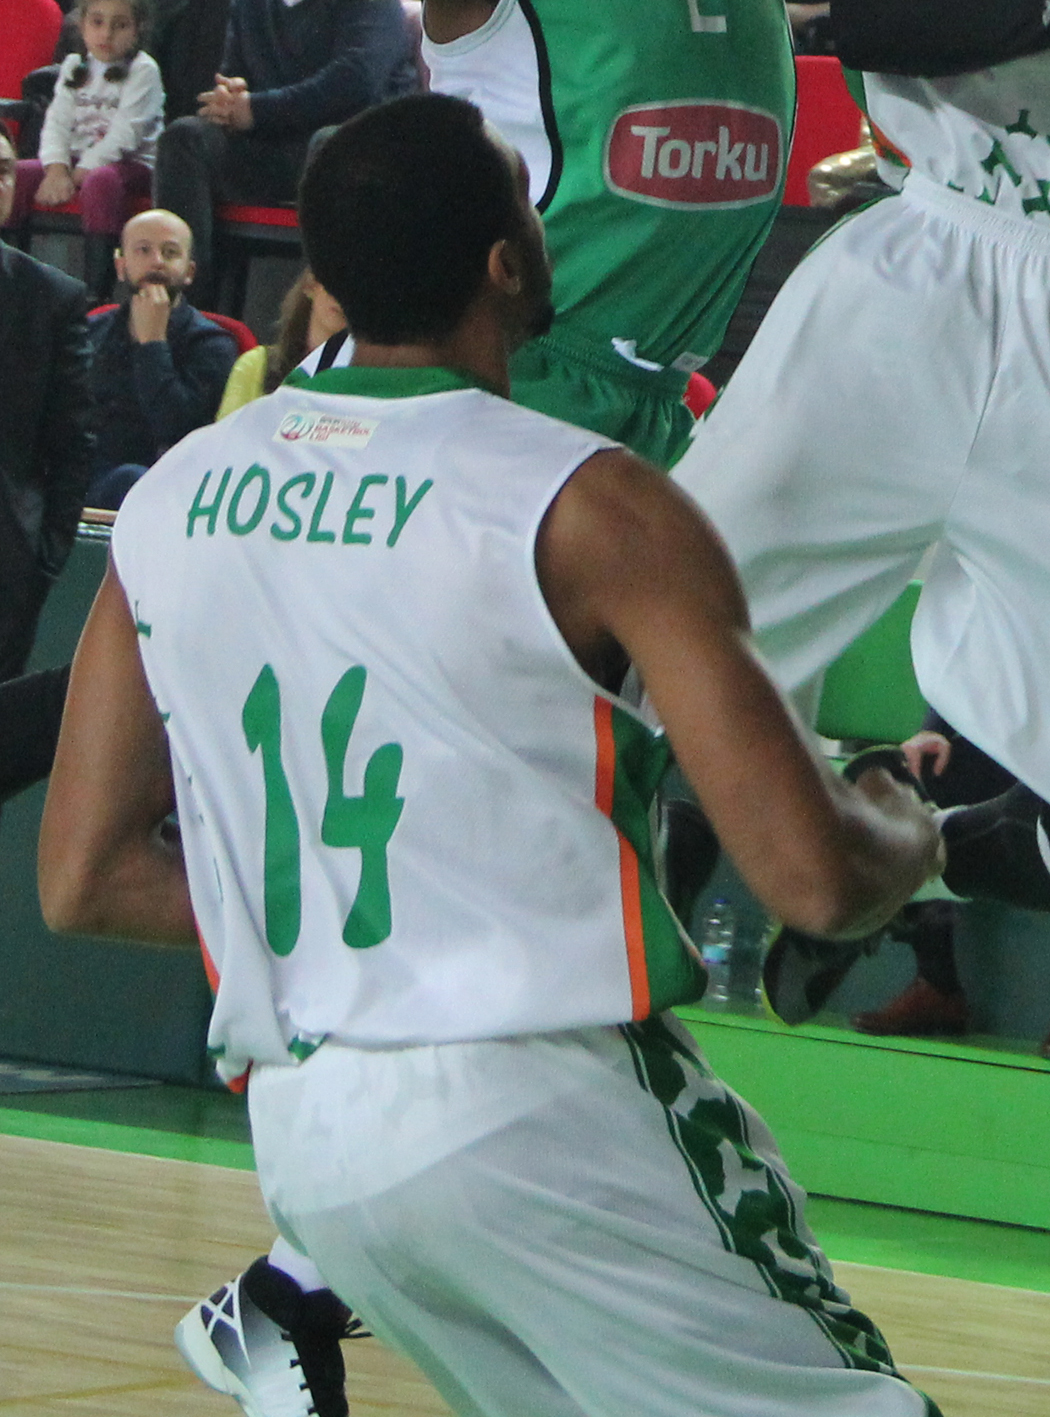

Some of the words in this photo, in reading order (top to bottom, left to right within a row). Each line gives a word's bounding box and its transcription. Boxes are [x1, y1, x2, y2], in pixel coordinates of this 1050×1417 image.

[630, 125, 769, 182] Torku
[186, 461, 434, 548] HOSLEY
[242, 663, 405, 957] 14
